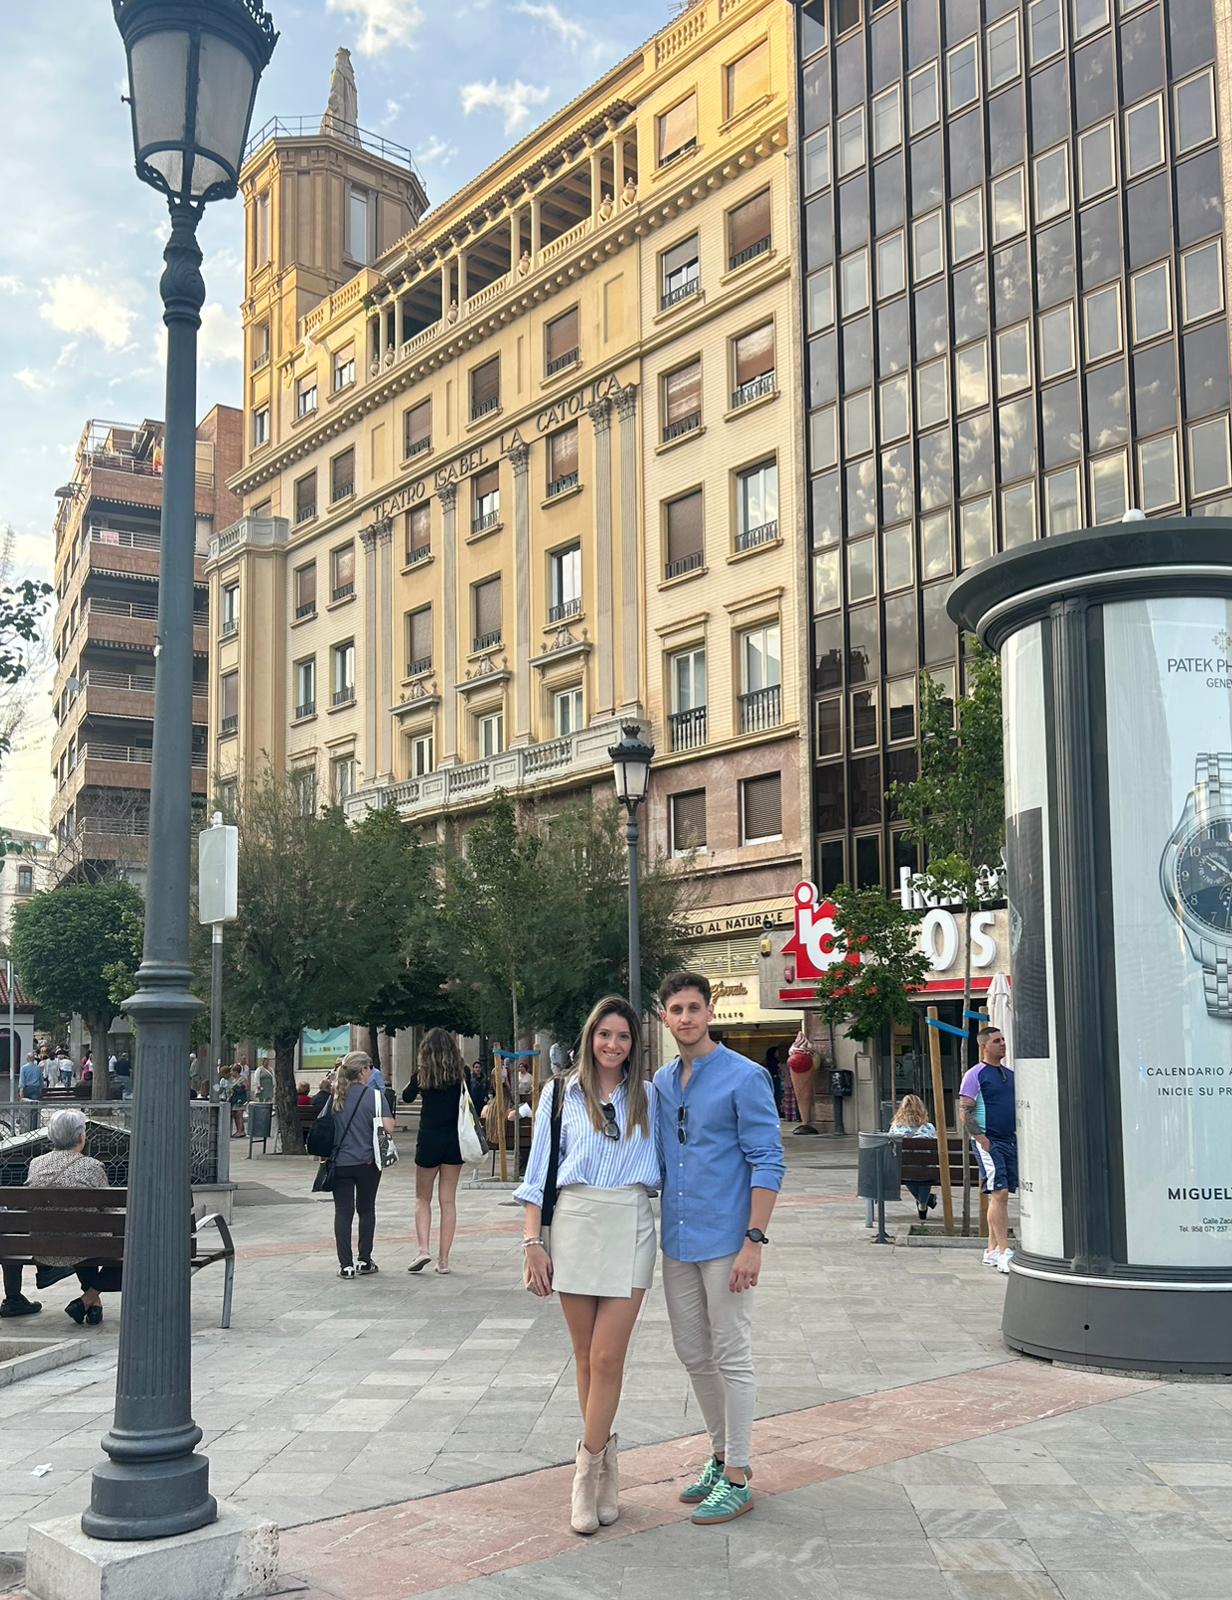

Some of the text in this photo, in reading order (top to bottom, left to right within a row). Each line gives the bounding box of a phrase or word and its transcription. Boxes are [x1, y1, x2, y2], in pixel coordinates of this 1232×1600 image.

[373, 373, 621, 522] TEATRO ISABEL LA CATOLICA
[1168, 658, 1213, 672] PATEK
[1206, 677, 1232, 689] GENE
[1189, 846, 1201, 857] 10
[1191, 894, 1198, 906] 8
[708, 922, 722, 932] AL
[1147, 1067, 1224, 1076] CALENDARIO
[1158, 1087, 1194, 1096] INICIE
[1199, 1087, 1214, 1096] SU
